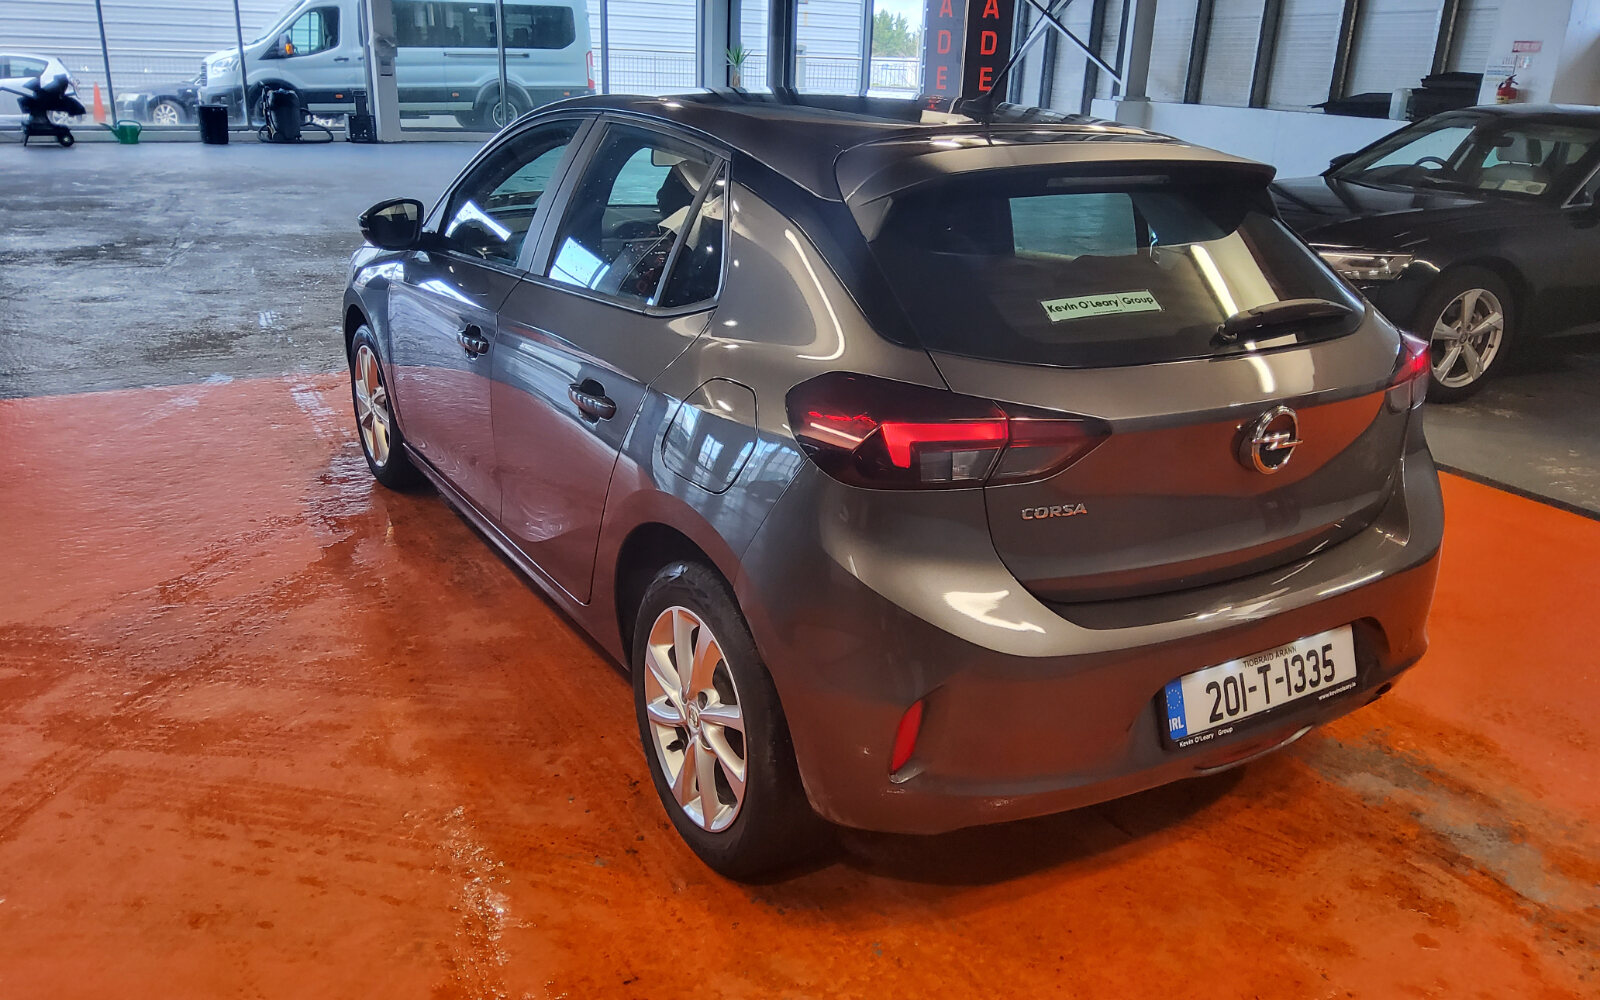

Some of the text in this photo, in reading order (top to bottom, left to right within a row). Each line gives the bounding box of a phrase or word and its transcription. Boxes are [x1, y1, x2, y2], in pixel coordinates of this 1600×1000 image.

[1047, 301, 1079, 314] Kevin
[1078, 298, 1119, 310] O'Leary
[1121, 295, 1154, 306] Group
[1021, 503, 1088, 520] CORSA
[1242, 645, 1297, 668] TIOBRAID ARANN
[1205, 643, 1336, 724] 201-T-1335
[1168, 716, 1185, 732] IRL
[1179, 726, 1234, 748] Kevin O'Leary Group
